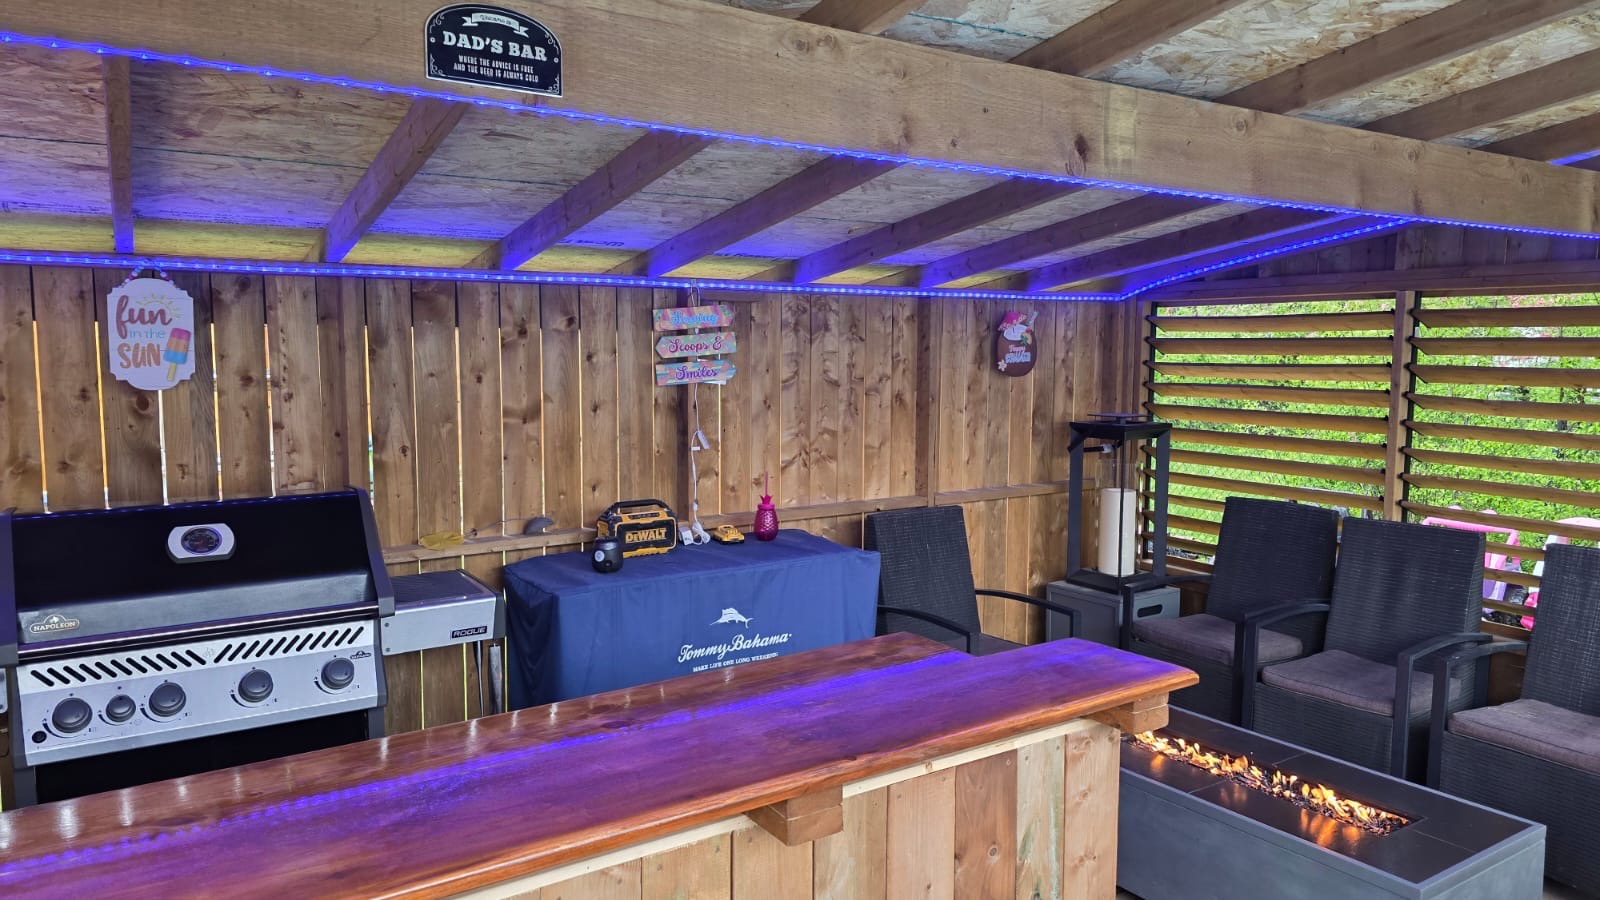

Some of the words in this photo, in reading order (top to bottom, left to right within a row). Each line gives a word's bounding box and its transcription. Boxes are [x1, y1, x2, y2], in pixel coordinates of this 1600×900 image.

[442, 31, 503, 54] DAD'S
[508, 42, 547, 61] BAR
[453, 63, 466, 71] AND
[468, 65, 478, 74] THE
[480, 66, 493, 77] BEER
[495, 69, 502, 78] IS
[503, 71, 524, 80] ALWAYS
[525, 73, 539, 83] COLD
[458, 55, 477, 65] WHERE
[480, 58, 490, 67] THE
[492, 60, 511, 70] ADVICE
[513, 63, 519, 72] IS
[521, 64, 534, 74] FREE
[116, 295, 172, 339] fun
[129, 329, 142, 338] in
[146, 328, 165, 338] the
[669, 339, 708, 353] Scoops
[712, 336, 721, 350] &
[117, 342, 161, 369] SUN
[675, 366, 717, 380] Smiles
[33, 621, 76, 631] NAPOLEON
[453, 627, 486, 637] ROGUE
[678, 643, 728, 663] Tommy
[728, 633, 788, 652] Bahama
[693, 664, 708, 673] MAKE
[709, 661, 721, 669] LIFE
[723, 659, 734, 667] ONE
